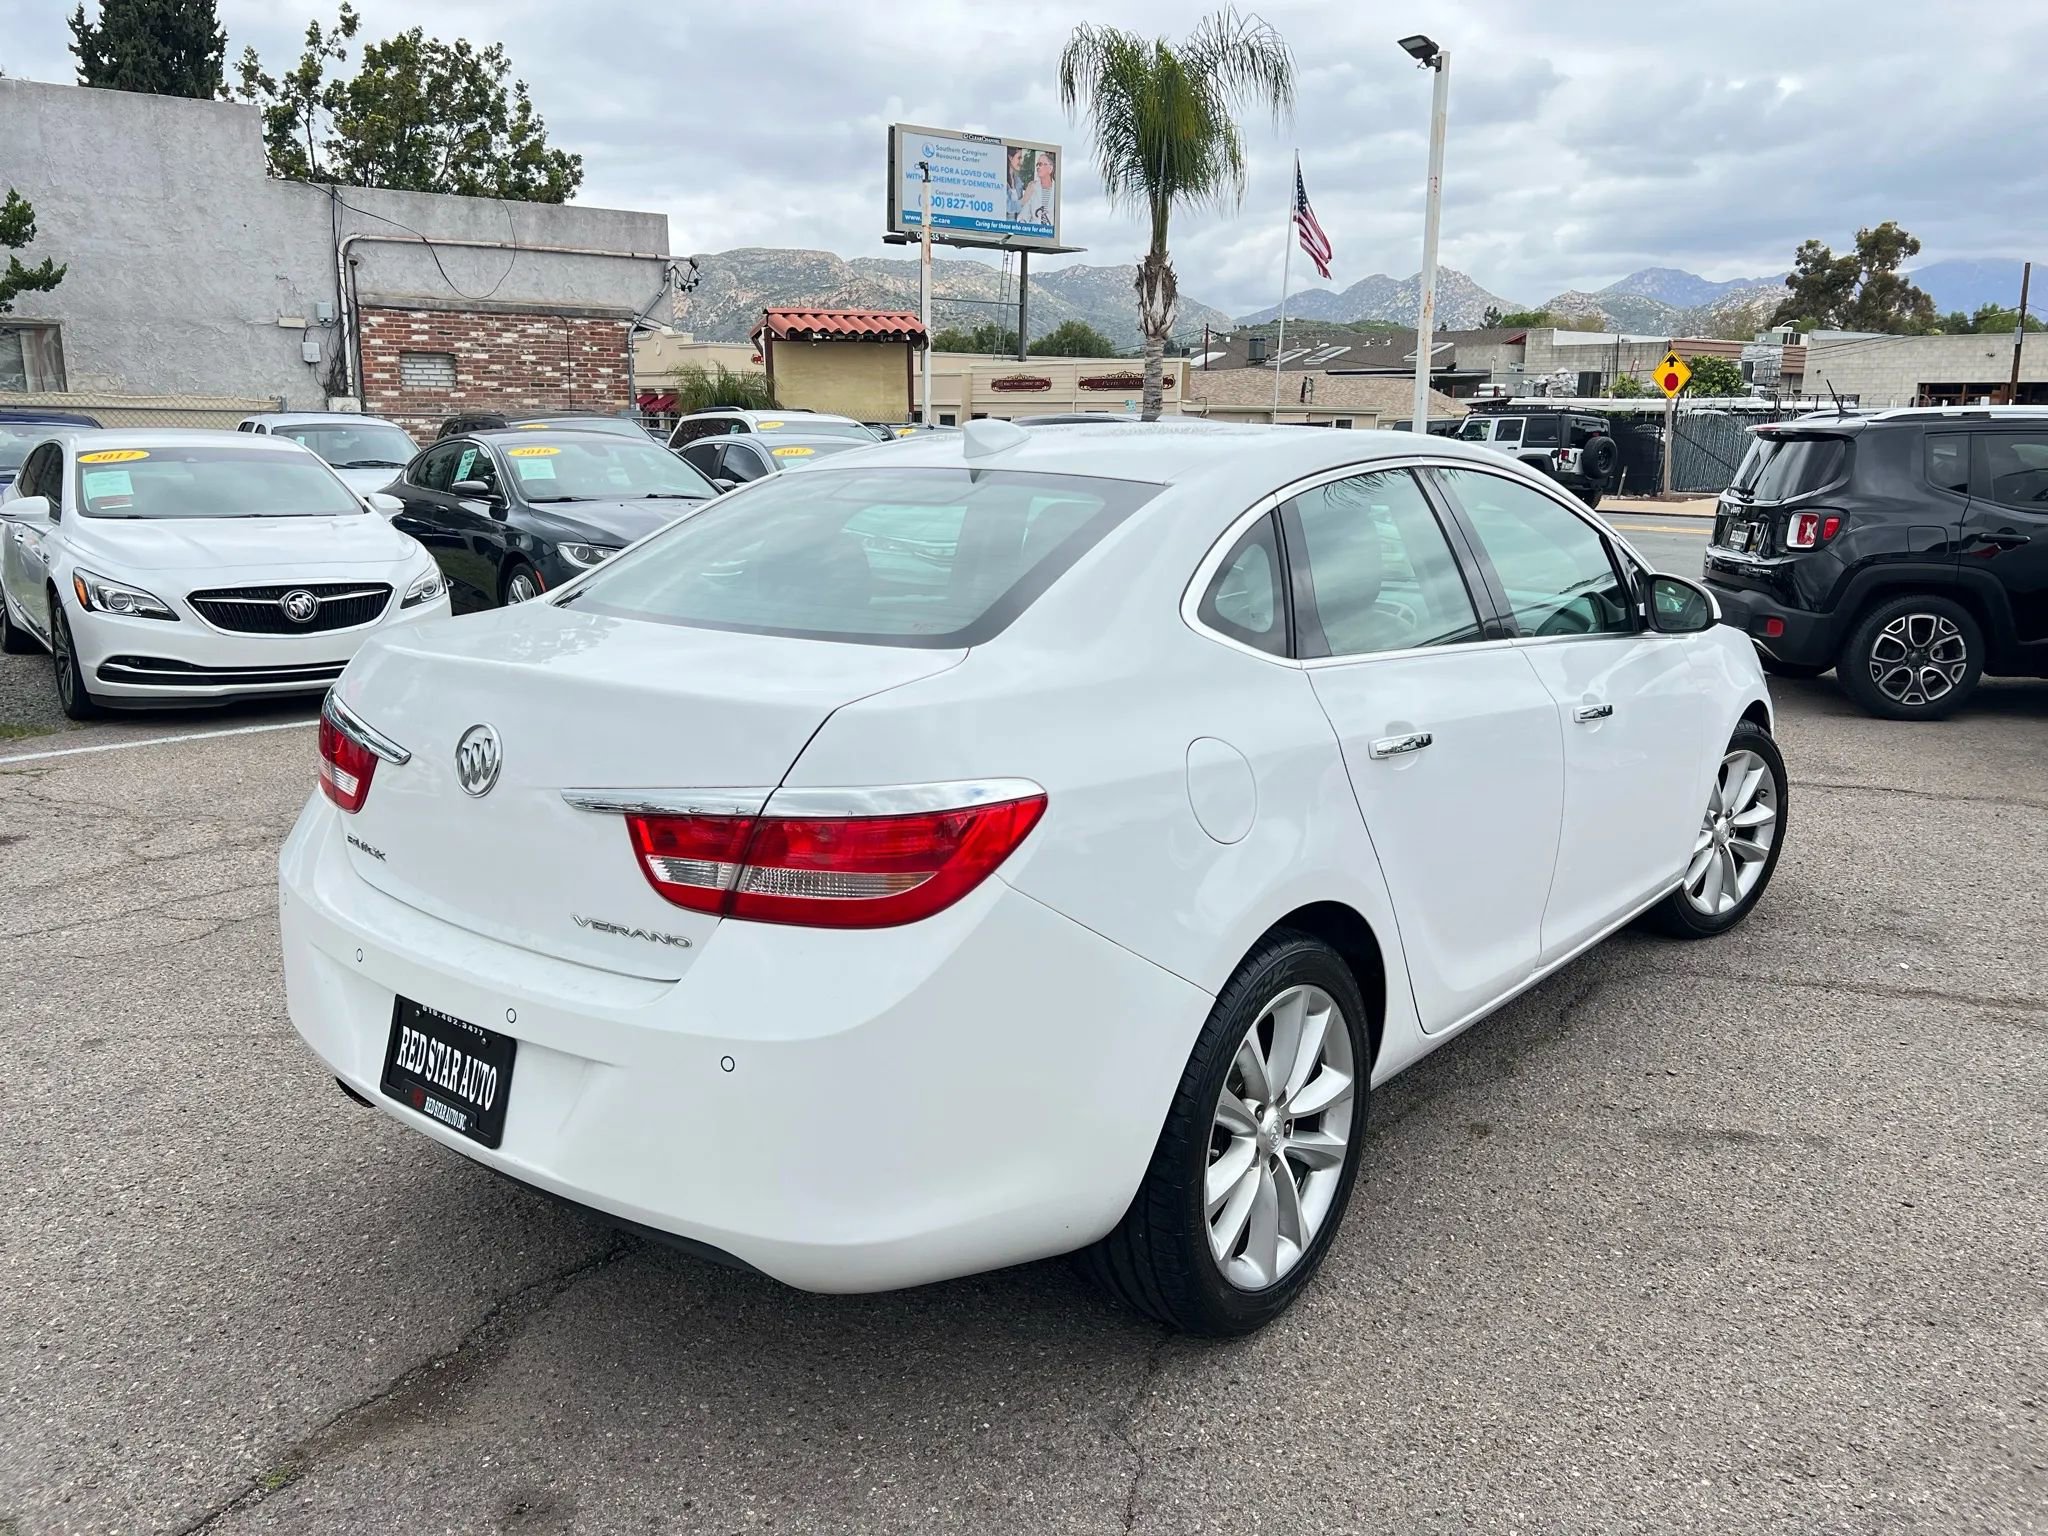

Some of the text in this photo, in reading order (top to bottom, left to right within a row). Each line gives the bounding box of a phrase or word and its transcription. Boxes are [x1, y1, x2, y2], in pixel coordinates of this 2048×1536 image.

[936, 144, 988, 157] Southern Caregiver
[905, 172, 923, 180] WITH
[914, 163, 939, 173] CNG
[940, 166, 954, 174] FOR
[960, 169, 982, 177] LOVED
[946, 198, 993, 212] 827-1008
[975, 220, 990, 229] Caring
[94, 452, 136, 462] 2017
[346, 833, 387, 862] BUICK
[569, 913, 693, 950] VERANO
[396, 1025, 497, 1111] RED STAR AUTO
[423, 1096, 436, 1115] RED
[433, 1100, 448, 1121] STAR
